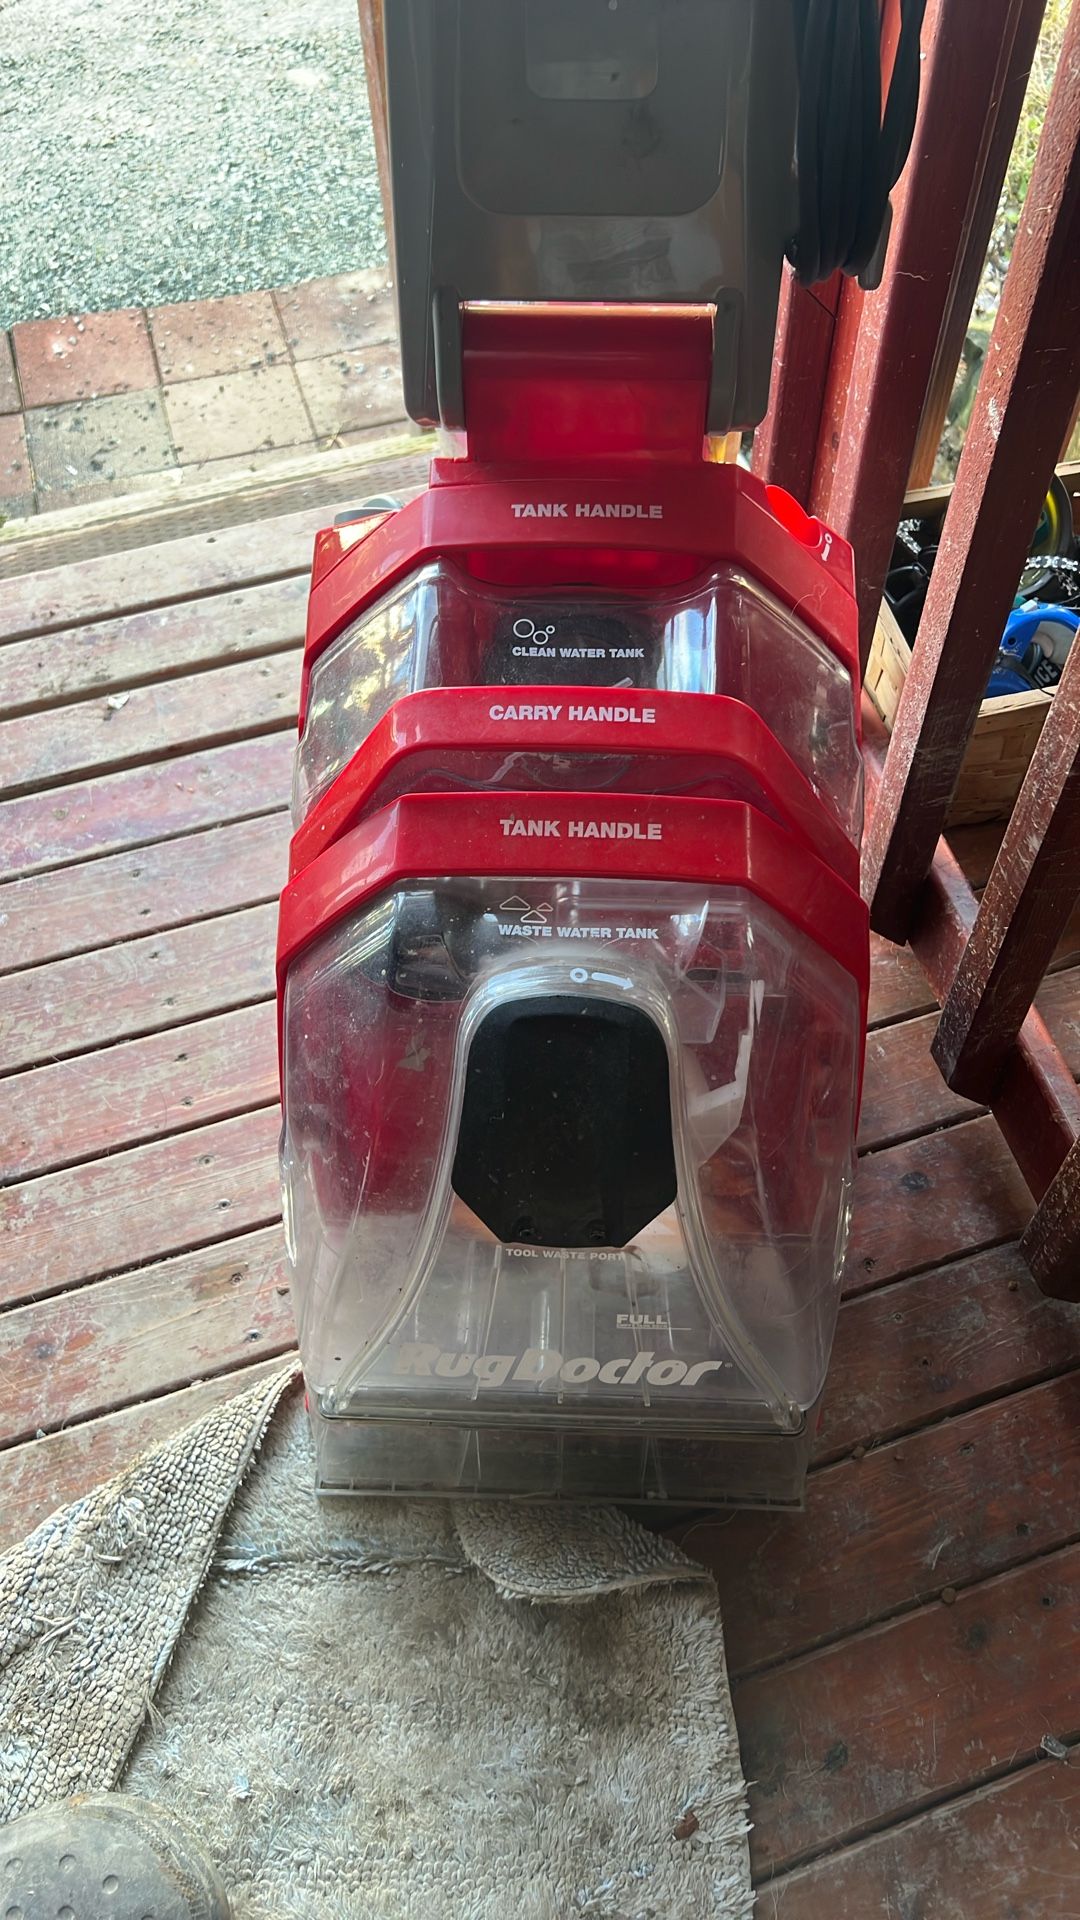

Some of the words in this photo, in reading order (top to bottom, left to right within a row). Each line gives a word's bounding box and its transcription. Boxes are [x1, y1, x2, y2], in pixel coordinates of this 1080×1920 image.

[511, 504, 568, 518] TANK
[575, 504, 663, 519] HANDLE
[512, 646, 556, 657] CLEAN
[560, 648, 606, 658] WATER
[609, 648, 645, 658] TANK
[489, 705, 562, 720] CARRY
[568, 706, 656, 723] HANDLE
[500, 820, 560, 837] TANK
[568, 821, 662, 839] HANDLE
[498, 924, 552, 937] WASTE
[556, 927, 612, 938] WATER
[616, 927, 659, 939] TANK
[506, 1248, 538, 1258] TOOL
[542, 1250, 585, 1260] WASTE
[590, 1252, 625, 1261] PORT
[616, 1314, 667, 1325] FULL
